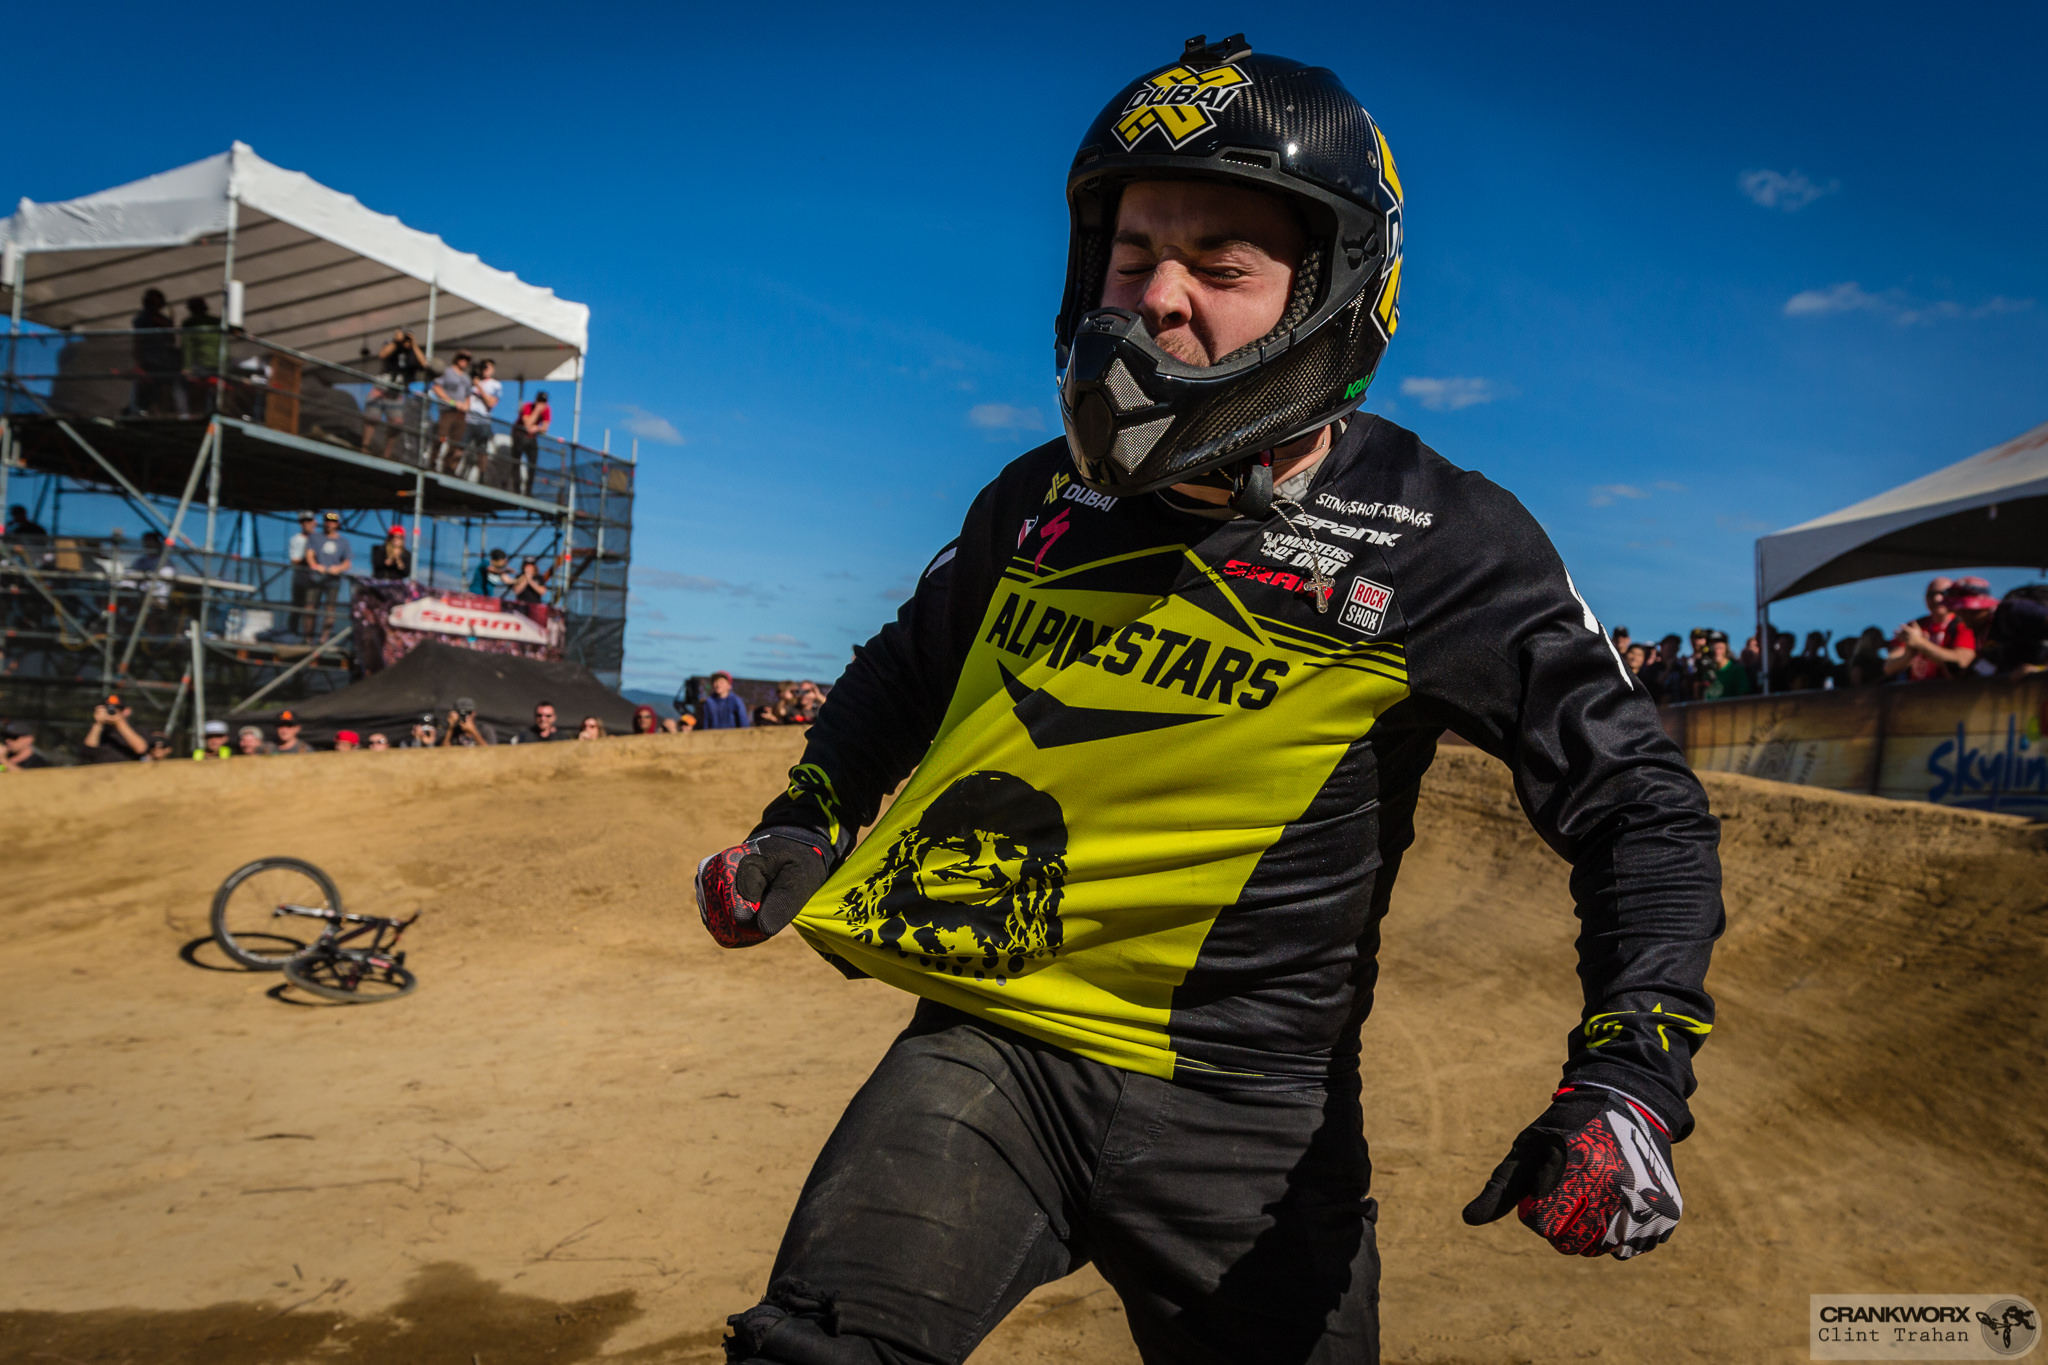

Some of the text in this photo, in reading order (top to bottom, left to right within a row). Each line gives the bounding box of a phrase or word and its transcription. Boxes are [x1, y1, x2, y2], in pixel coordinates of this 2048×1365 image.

[1126, 84, 1235, 112] DUBAI
[1062, 483, 1119, 512] DUBAI
[1280, 535, 1354, 563] MASTERS
[1354, 583, 1388, 609] ROCK
[1346, 605, 1380, 631] SHOX
[985, 593, 1291, 710] ALPINESTARS
